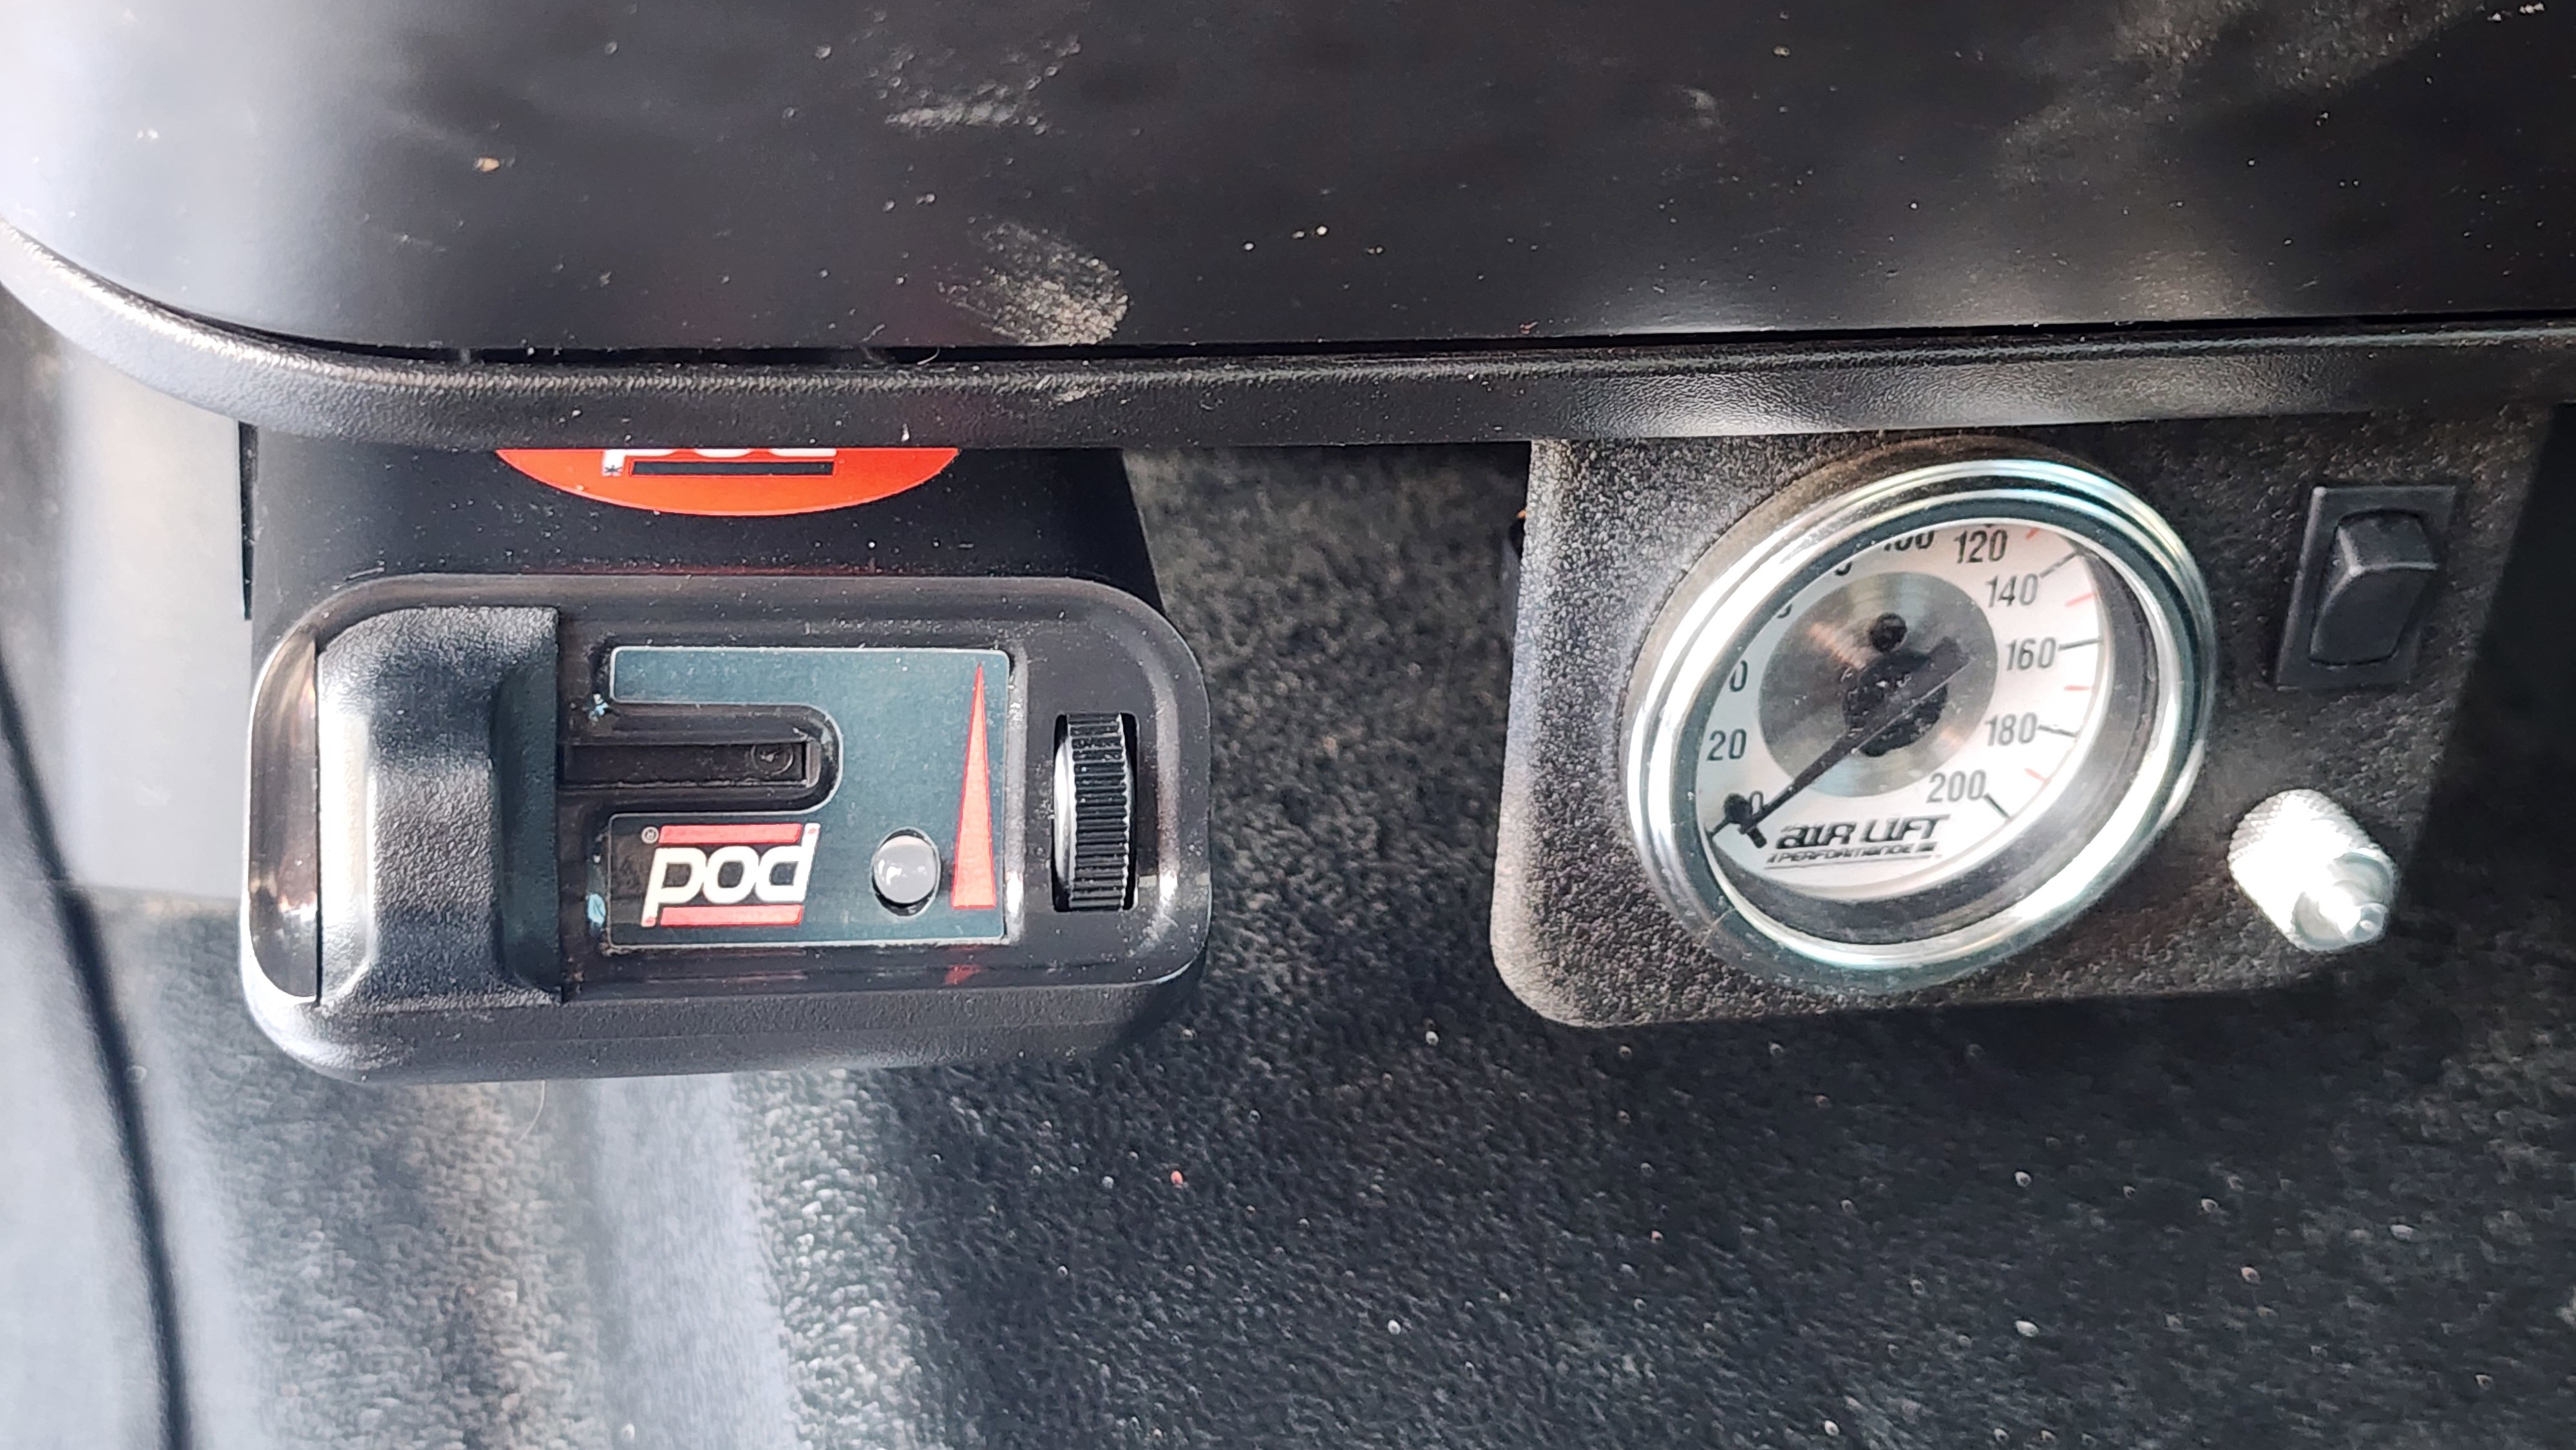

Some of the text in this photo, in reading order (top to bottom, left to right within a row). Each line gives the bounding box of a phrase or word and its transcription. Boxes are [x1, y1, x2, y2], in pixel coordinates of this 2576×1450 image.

[1954, 528, 2009, 563] 120
[1985, 572, 2040, 608] 140
[2005, 636, 2056, 672] 160
[1707, 728, 1747, 761] 20
[1984, 712, 2038, 747] 180
[1926, 769, 1987, 804] 200
[641, 823, 821, 927] pod
